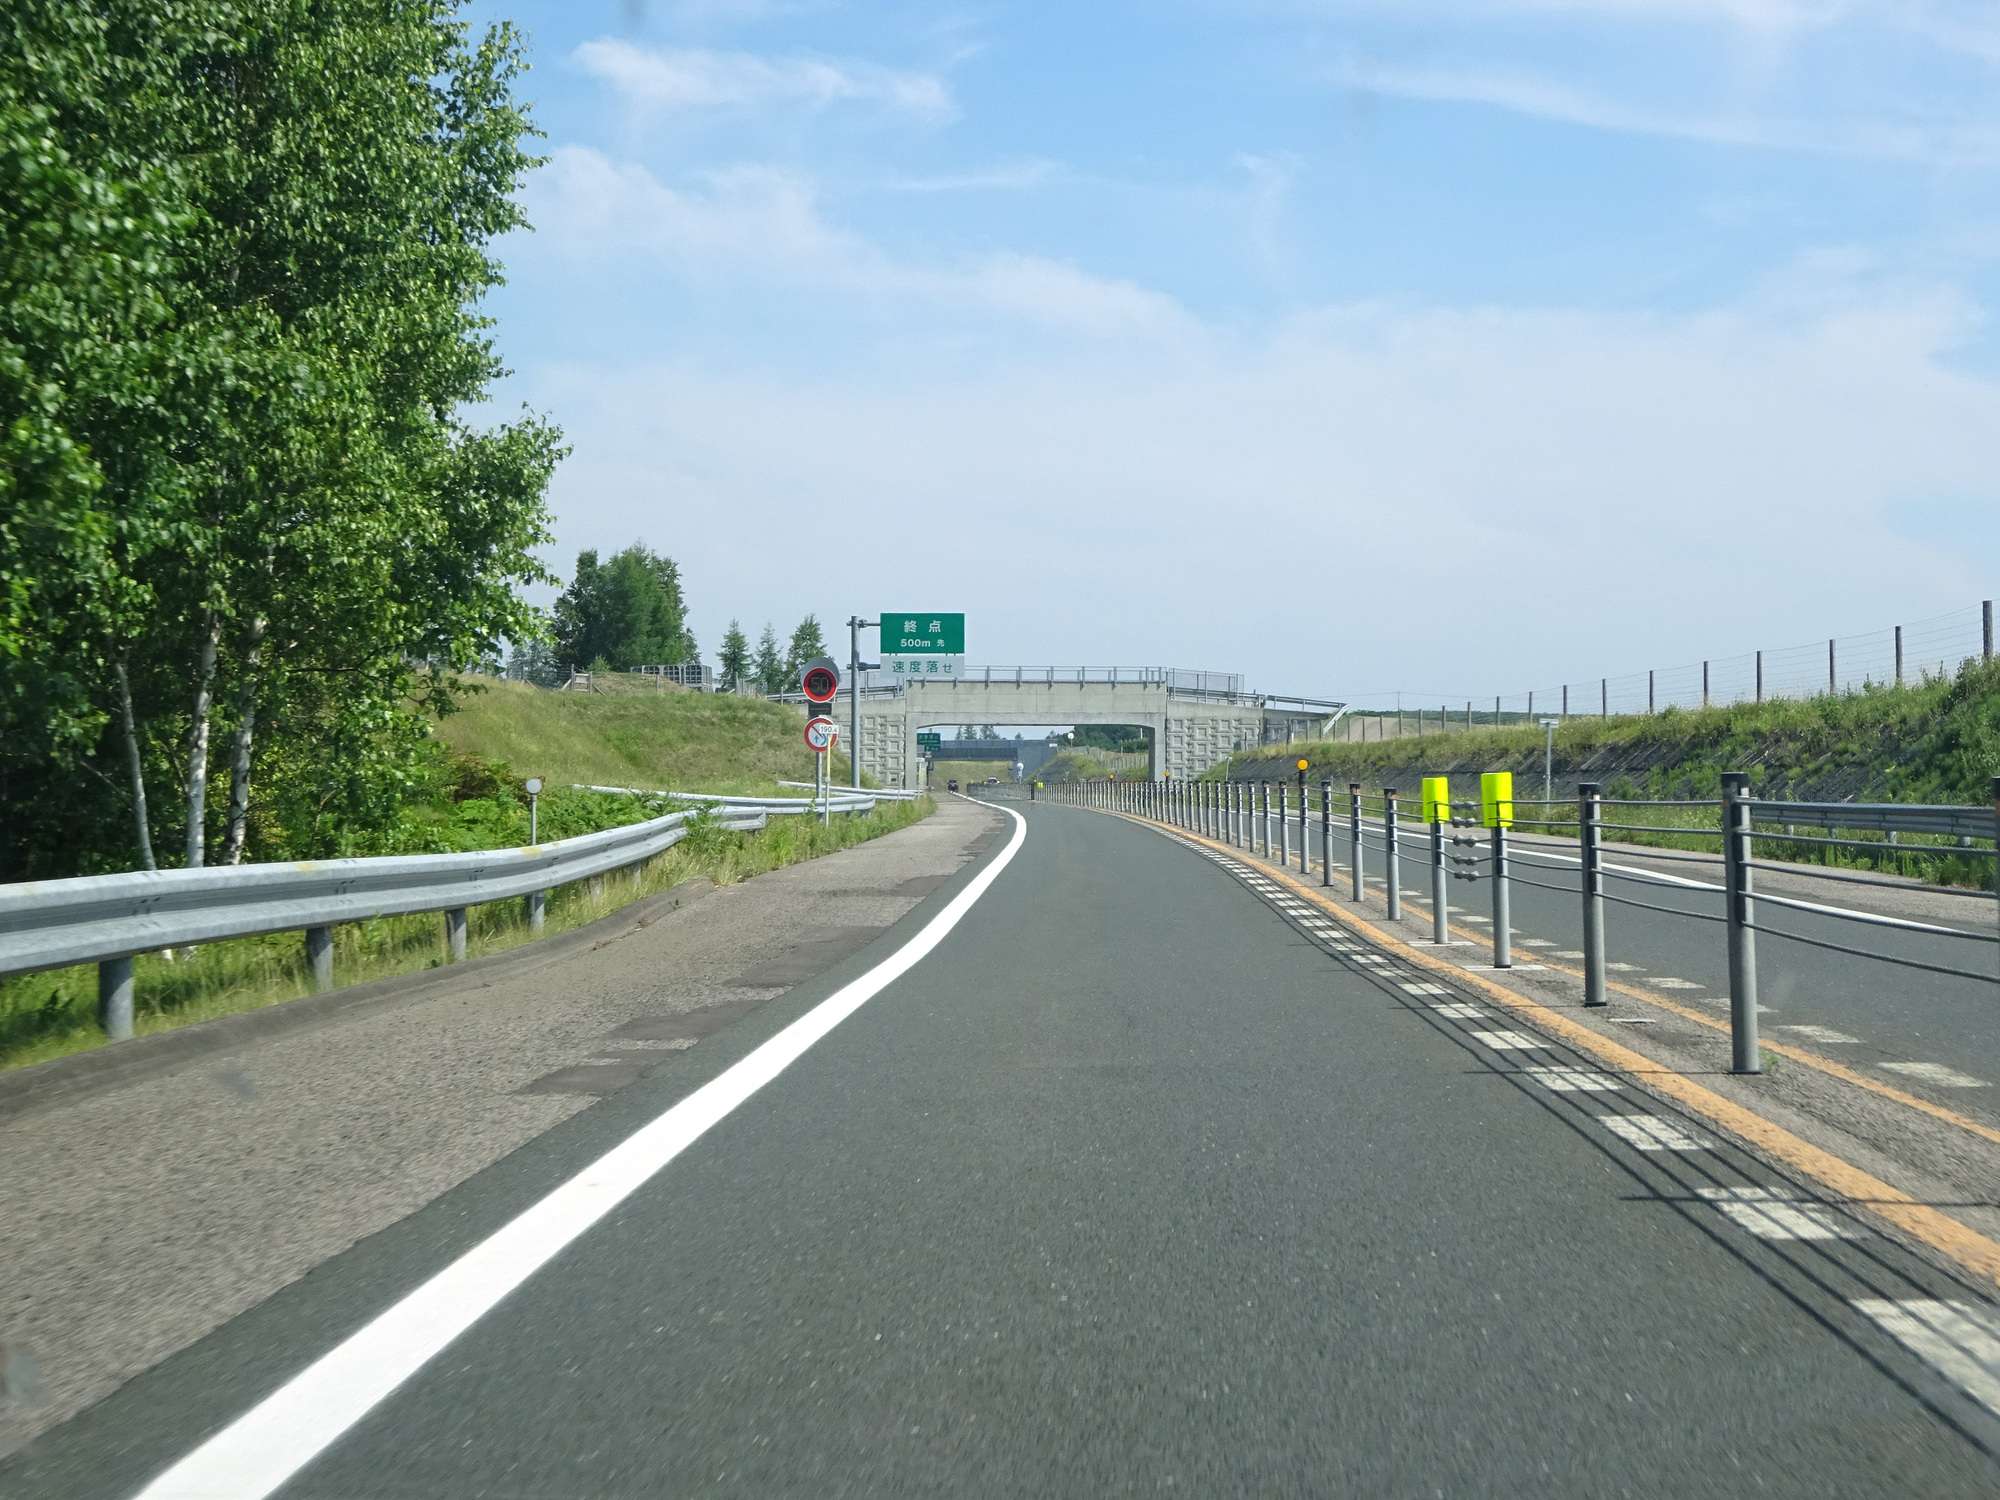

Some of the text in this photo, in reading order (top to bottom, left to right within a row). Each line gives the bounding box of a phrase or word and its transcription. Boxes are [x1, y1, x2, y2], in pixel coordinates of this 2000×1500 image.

[903, 620, 942, 633] 終点
[900, 638, 931, 647] 500m
[892, 660, 953, 673] 速度落せ
